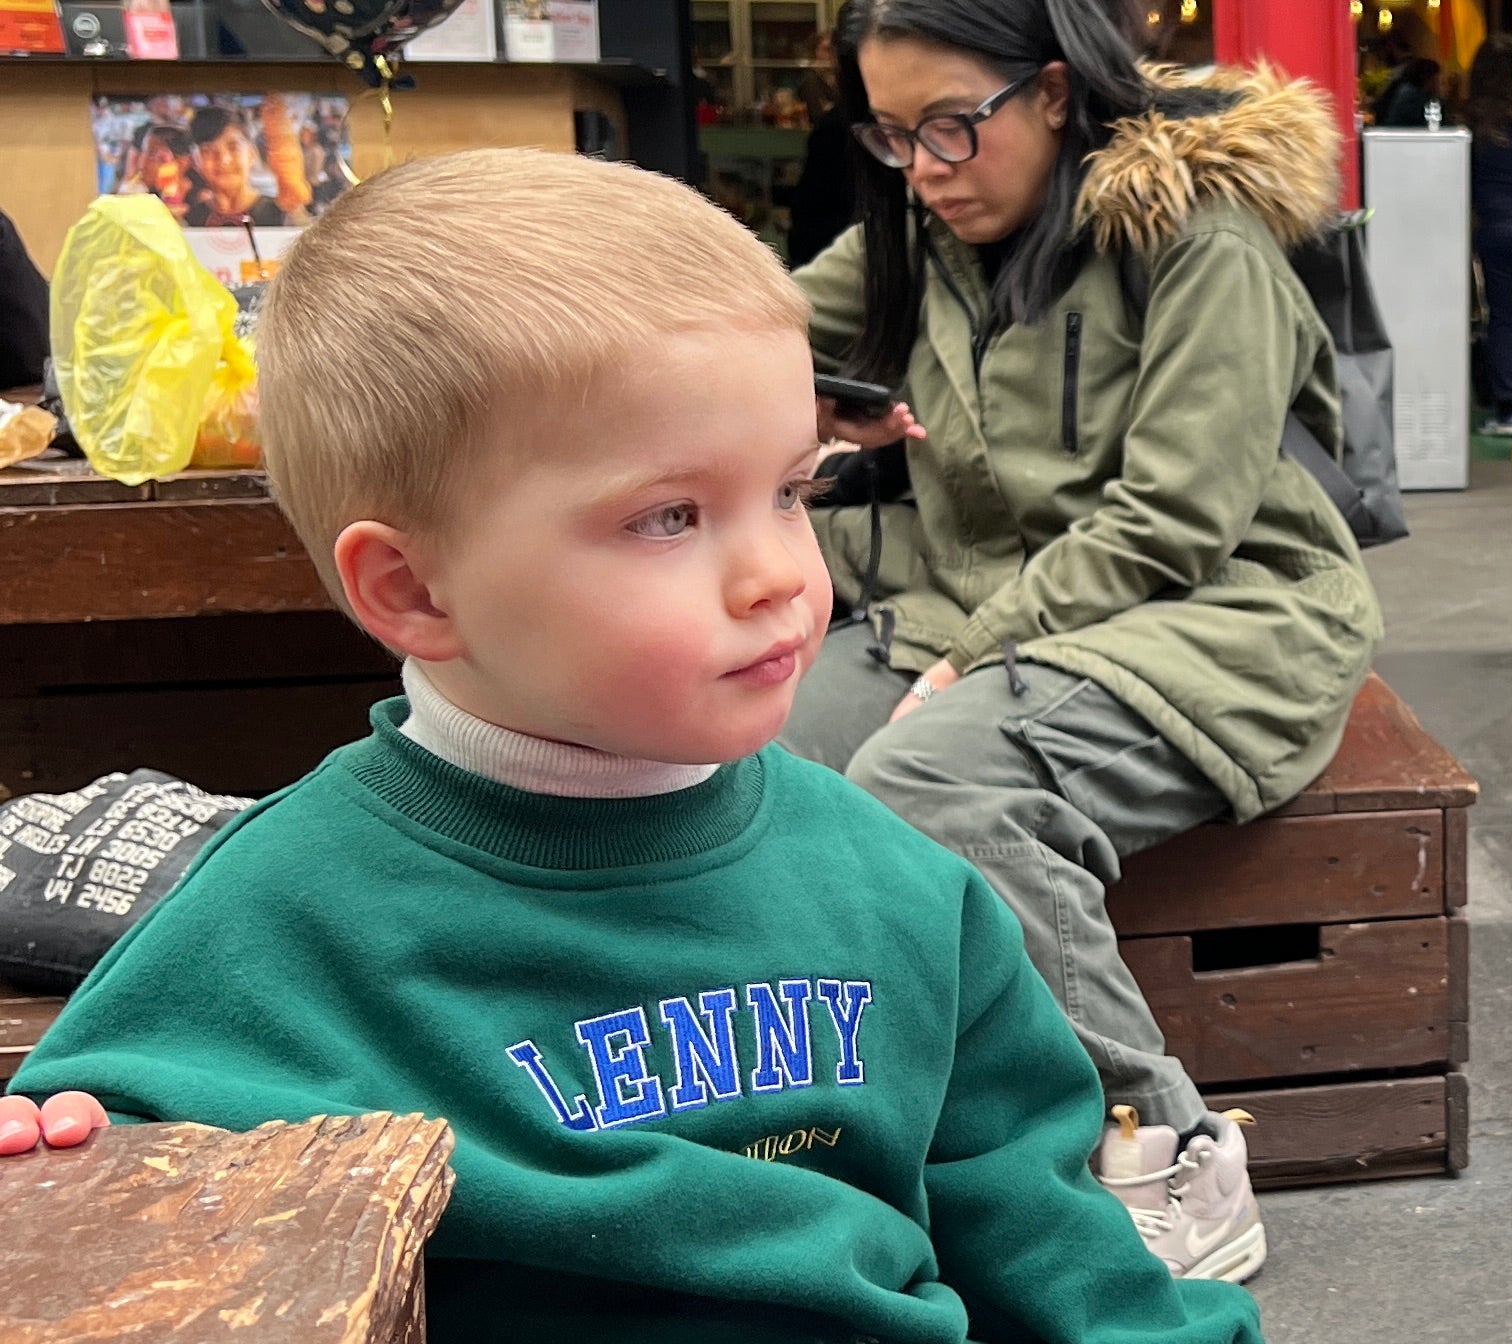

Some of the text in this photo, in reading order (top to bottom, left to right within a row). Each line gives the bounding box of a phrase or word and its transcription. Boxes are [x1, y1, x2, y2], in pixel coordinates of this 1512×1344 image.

[117, 819, 181, 852] 6530
[99, 839, 166, 870] 3005
[56, 854, 149, 894] TJ 8022
[76, 883, 136, 916] 2456
[505, 976, 873, 1132] LENNY
